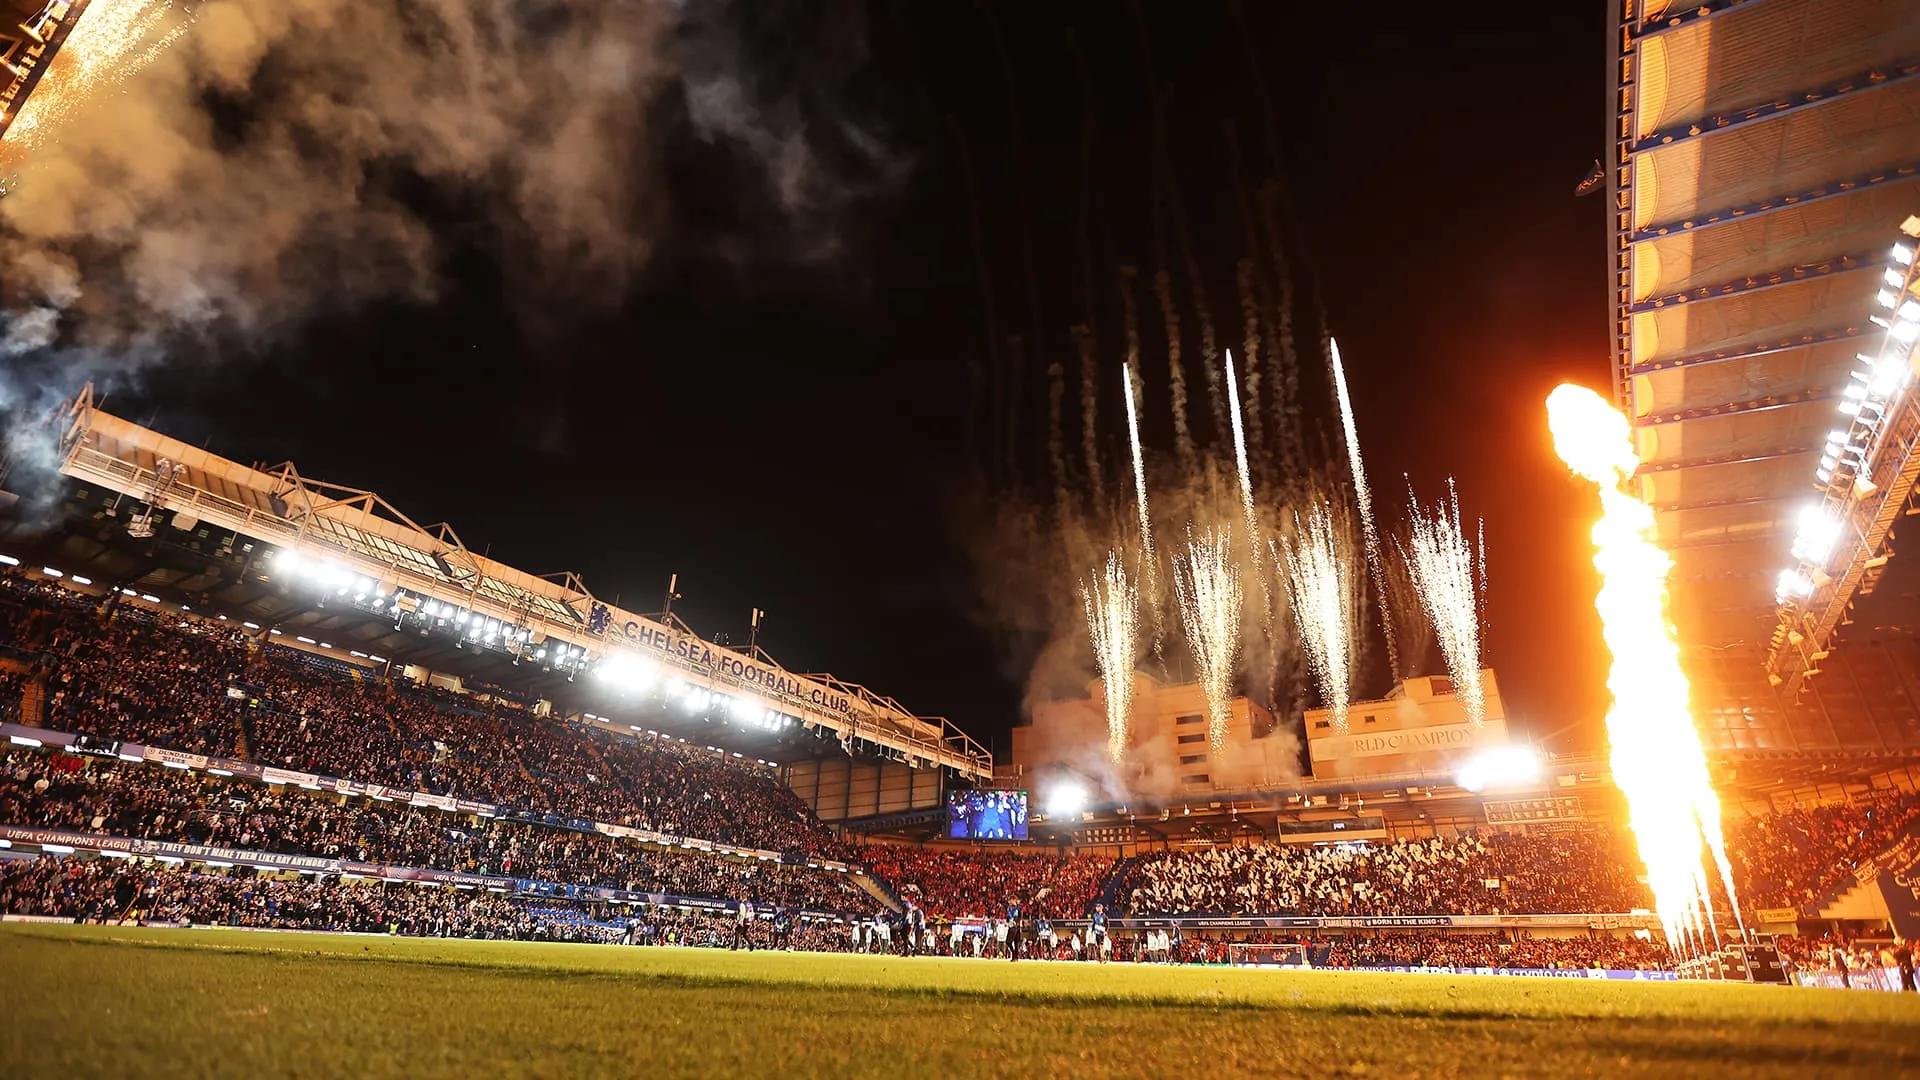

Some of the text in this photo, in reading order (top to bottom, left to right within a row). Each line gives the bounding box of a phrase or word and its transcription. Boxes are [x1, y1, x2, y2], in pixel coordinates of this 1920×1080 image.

[624, 620, 850, 713] CHELSEA FOOTBALL CLUB
[6, 829, 33, 841] UEFA
[36, 832, 94, 847] CHAMPIONS
[161, 841, 184, 853] THEY
[210, 847, 235, 859] MAKE
[258, 853, 275, 864] LIKE
[450, 875, 483, 886] CHAMPIONS
[484, 879, 505, 887] LEAGUE
